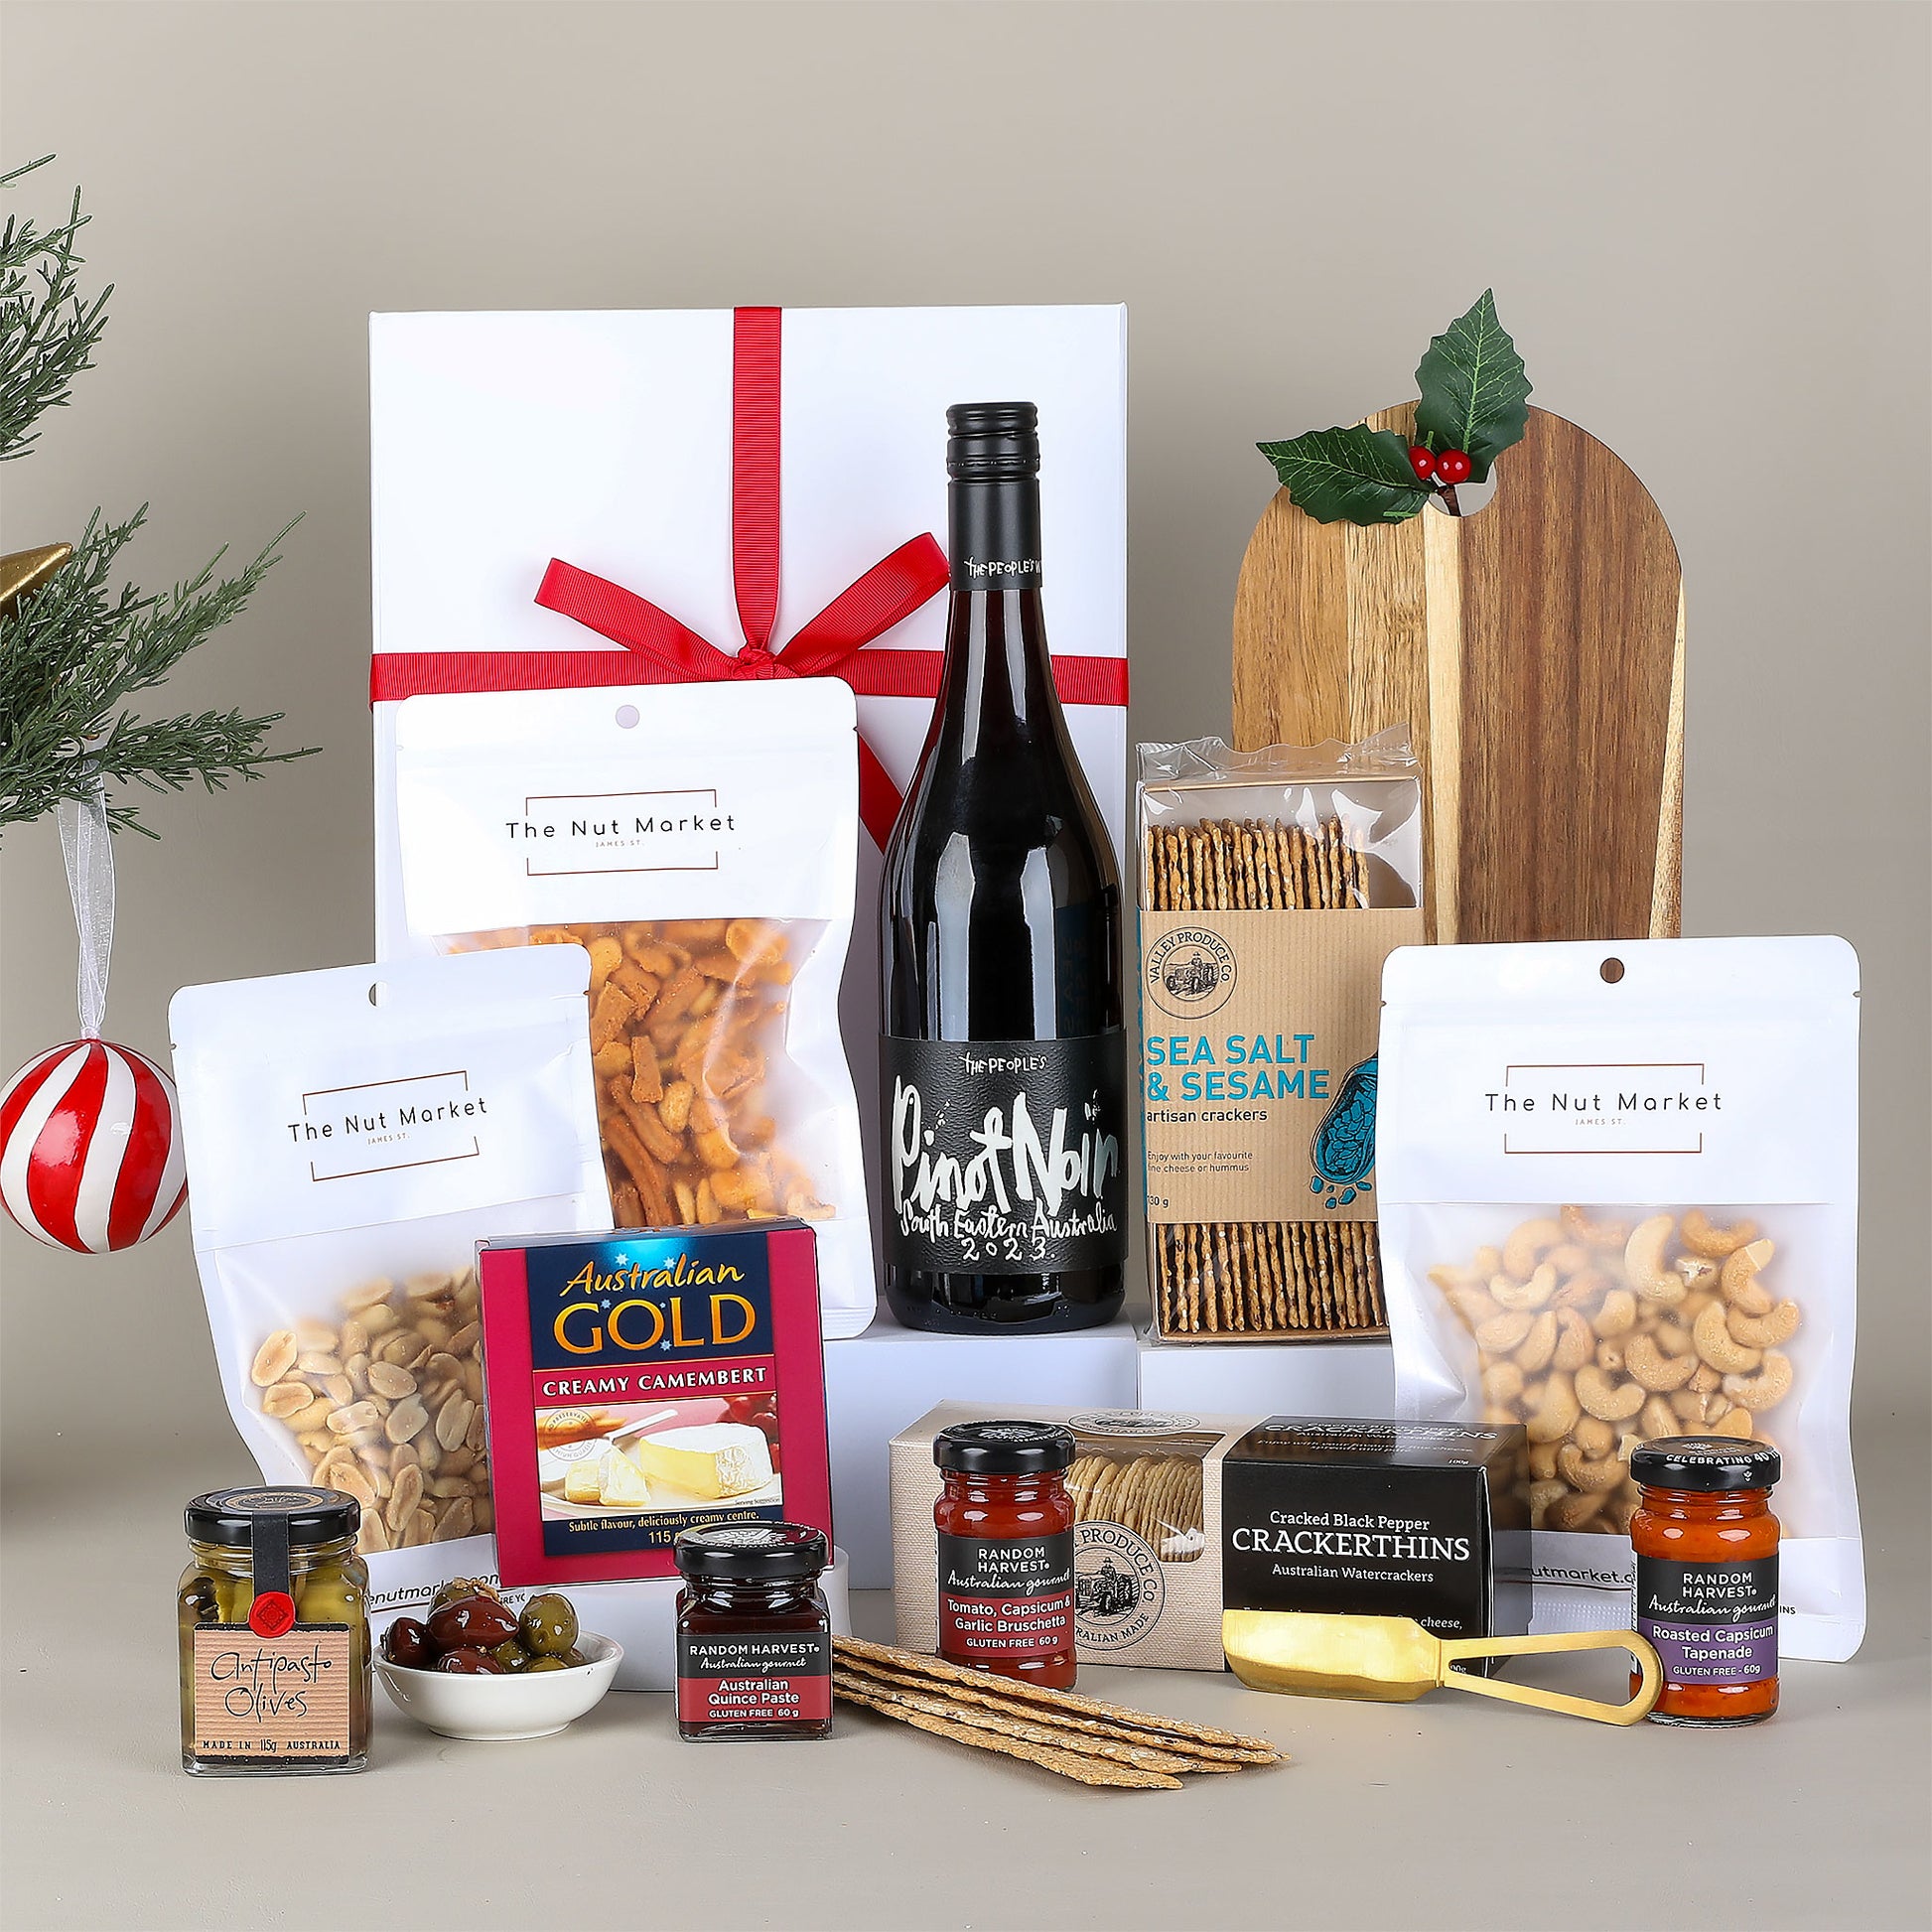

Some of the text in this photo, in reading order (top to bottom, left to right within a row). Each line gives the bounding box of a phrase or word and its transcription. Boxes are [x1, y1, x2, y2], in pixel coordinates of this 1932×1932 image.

[505, 814, 735, 839] The Nut Market
[1150, 936, 1176, 984] VALLEY
[1176, 931, 1230, 963] PRODUCE
[1147, 1034, 1315, 1066] SEA SALT
[1147, 1069, 1330, 1102] & SESAME
[1484, 1092, 1723, 1112] The Nut Market
[287, 1097, 487, 1143] The Nut Market
[1146, 1108, 1268, 1124] artisan crackers
[367, 1134, 394, 1145] JAMES
[892, 1074, 1120, 1217] Pinot Noir
[1147, 1151, 1254, 1163] Enjoy with your favourite
[1164, 1164, 1195, 1173] cheese
[1209, 1164, 1250, 1173] hummus
[1147, 1195, 1170, 1208] 30 g
[900, 1196, 1118, 1243] South Eastern Australia
[559, 1253, 746, 1298] Australian
[553, 1293, 757, 1355] GOLD
[542, 1366, 768, 1398] CREAMY CAMEMBERT
[1666, 1453, 1752, 1465] CELEBRATING
[568, 1520, 598, 1533] Subtle
[600, 1516, 636, 1530] flavour,
[637, 1512, 689, 1528] deliciously
[726, 1509, 759, 1521] centre.
[1270, 1510, 1431, 1533] Cracked Black Pepper
[648, 1531, 671, 1545] 115
[1231, 1527, 1470, 1562] CRACKERTHINS
[978, 1546, 1045, 1561] RANDOM
[1080, 1528, 1159, 1603] PRODUCE CO.
[1272, 1563, 1435, 1583] Australian Watercrackers
[947, 1568, 1071, 1595] Australian gourmet
[1683, 1572, 1753, 1586] RANDOM
[947, 1595, 1071, 1618] Tomato, Capsicum &
[1648, 1593, 1777, 1622] Australian gourmet
[954, 1615, 1066, 1633] Garlic Bruschetta
[1075, 1612, 1150, 1643] RALIAN MADE
[1421, 1616, 1463, 1631] cheese,
[966, 1637, 1007, 1648] GLUTEN
[1009, 1637, 1035, 1647] FREE
[1652, 1624, 1774, 1644] Roasted Capsicum
[689, 1644, 749, 1656] RANDOM
[1681, 1645, 1753, 1662] Tapenade
[700, 1656, 807, 1673] Australian gourmet
[1673, 1665, 1711, 1677] GLUTEN
[1713, 1666, 1737, 1677] FREE
[1743, 1664, 1761, 1675] 60g
[718, 1679, 789, 1692] Australian
[224, 1683, 307, 1724] Olives
[708, 1692, 800, 1706] Quince Paste
[708, 1709, 748, 1719] GLUTEN
[749, 1709, 773, 1718] FREE
[777, 1708, 791, 1718] 60
[203, 1738, 341, 1753] MADE IN 115g AUSTRALIA
